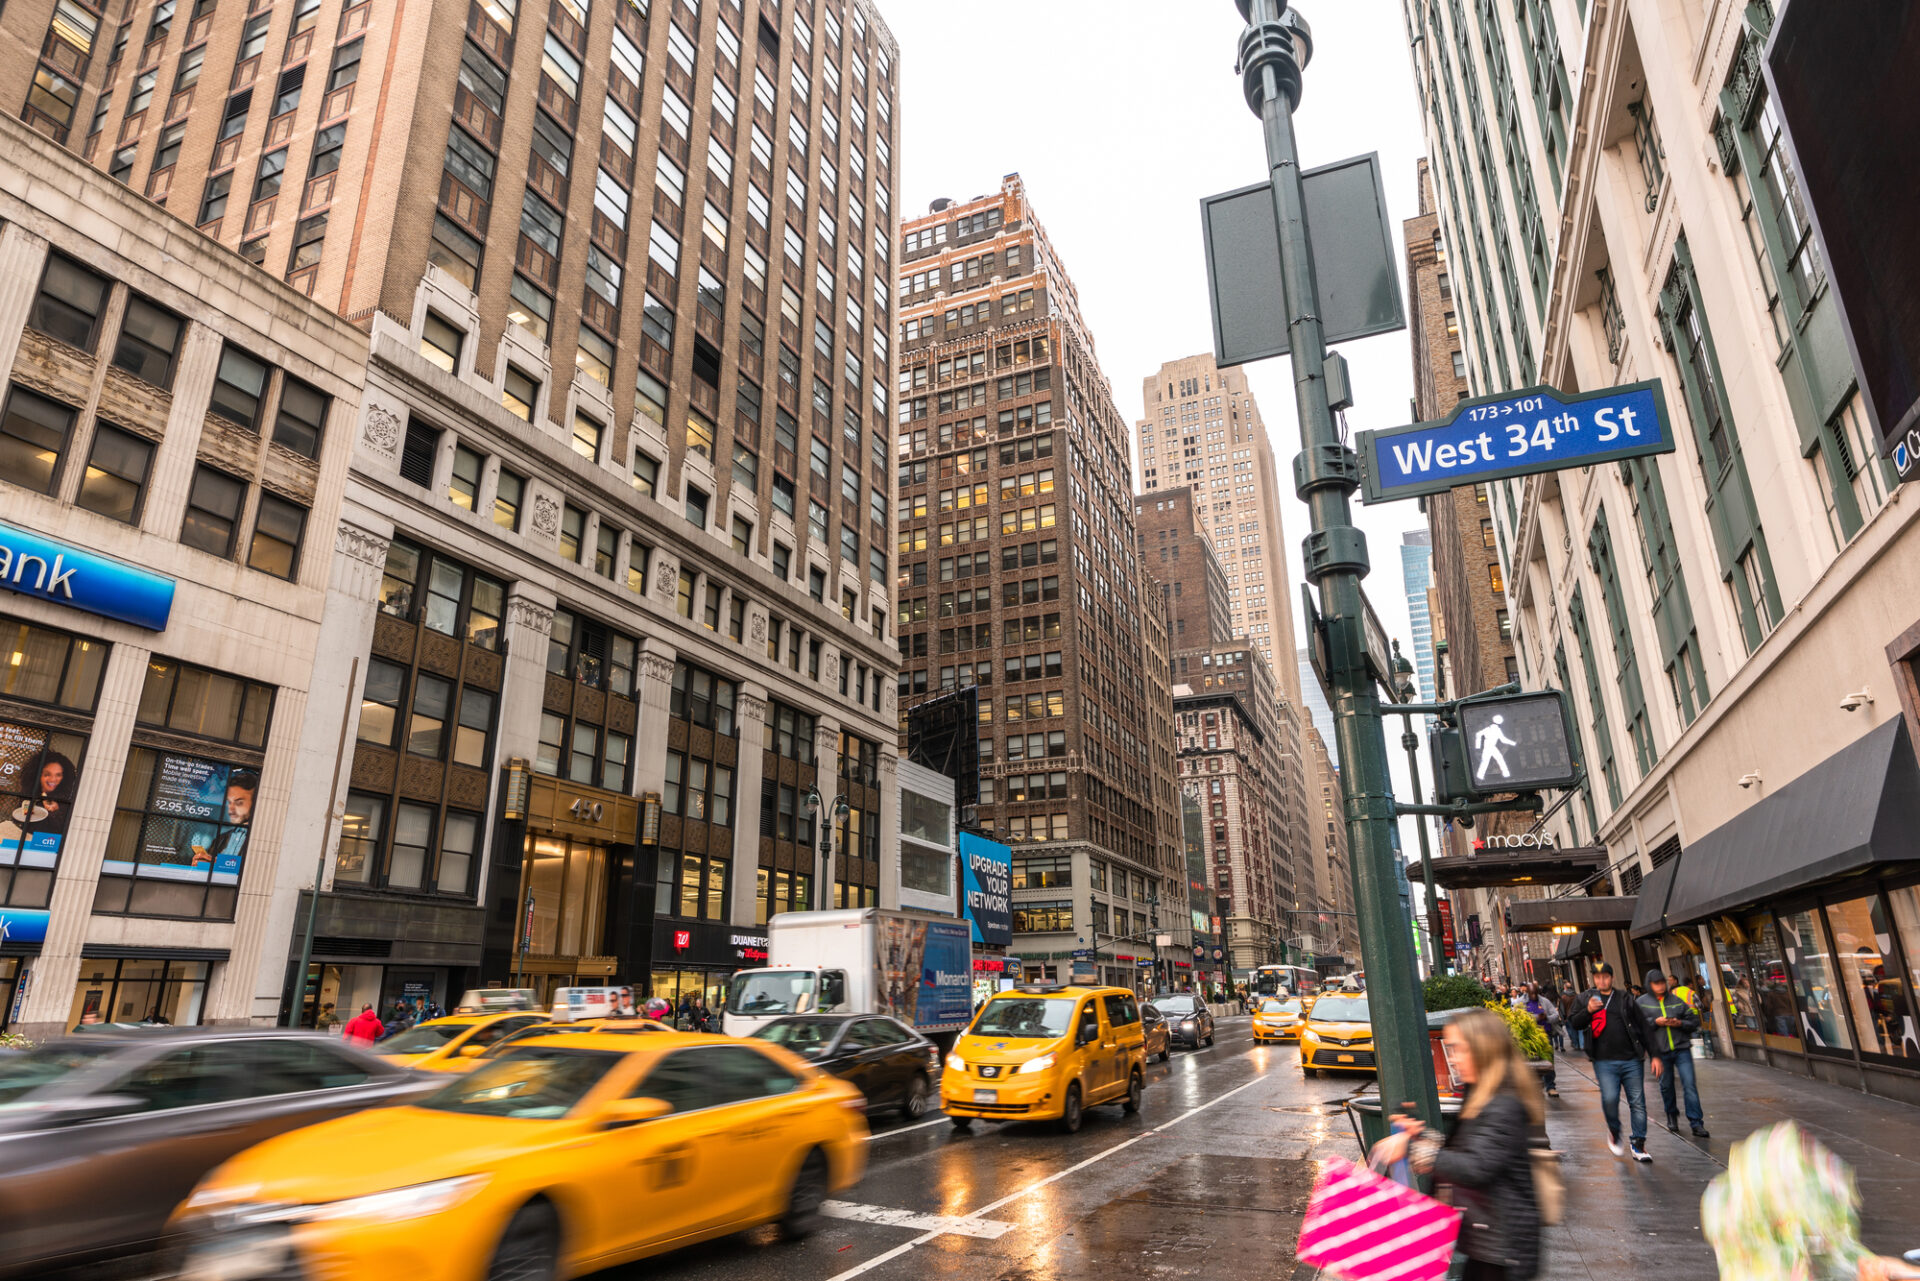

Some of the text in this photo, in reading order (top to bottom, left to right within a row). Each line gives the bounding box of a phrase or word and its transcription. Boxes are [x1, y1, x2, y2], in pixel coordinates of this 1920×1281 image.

[1469, 398, 1543, 422] 173 101
[1392, 406, 1640, 475] West 34th St
[570, 798, 603, 822] 450
[969, 853, 1008, 878] UPGRADE
[986, 876, 1008, 896] YOUR
[967, 890, 1008, 914] NETWORK
[936, 970, 969, 986] Monarch
